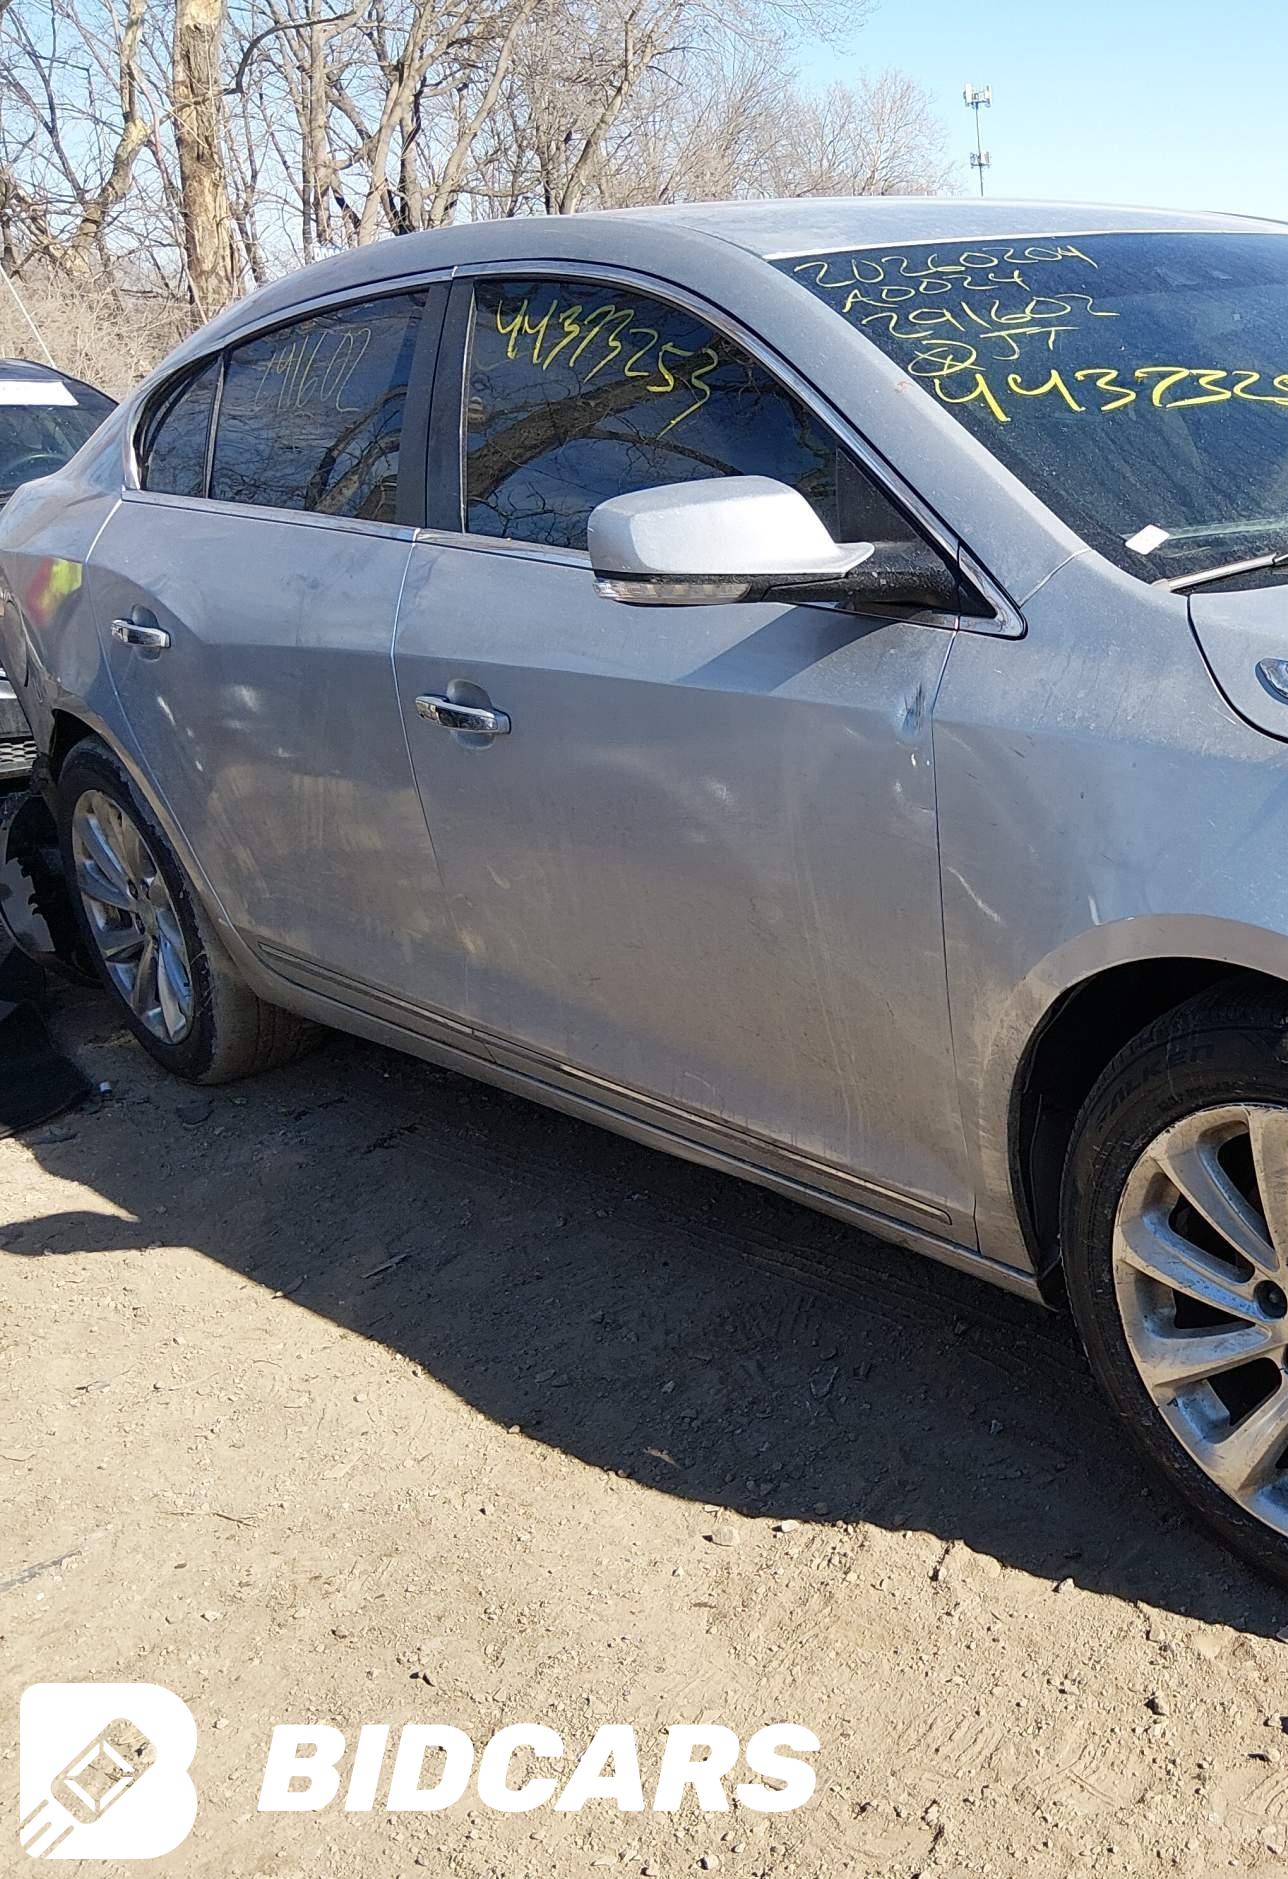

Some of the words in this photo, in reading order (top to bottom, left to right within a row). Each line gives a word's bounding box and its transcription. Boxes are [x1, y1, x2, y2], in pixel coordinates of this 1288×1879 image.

[794, 245, 1098, 288] 20260204
[862, 293, 1121, 338] 291602
[497, 299, 718, 440] 44373253
